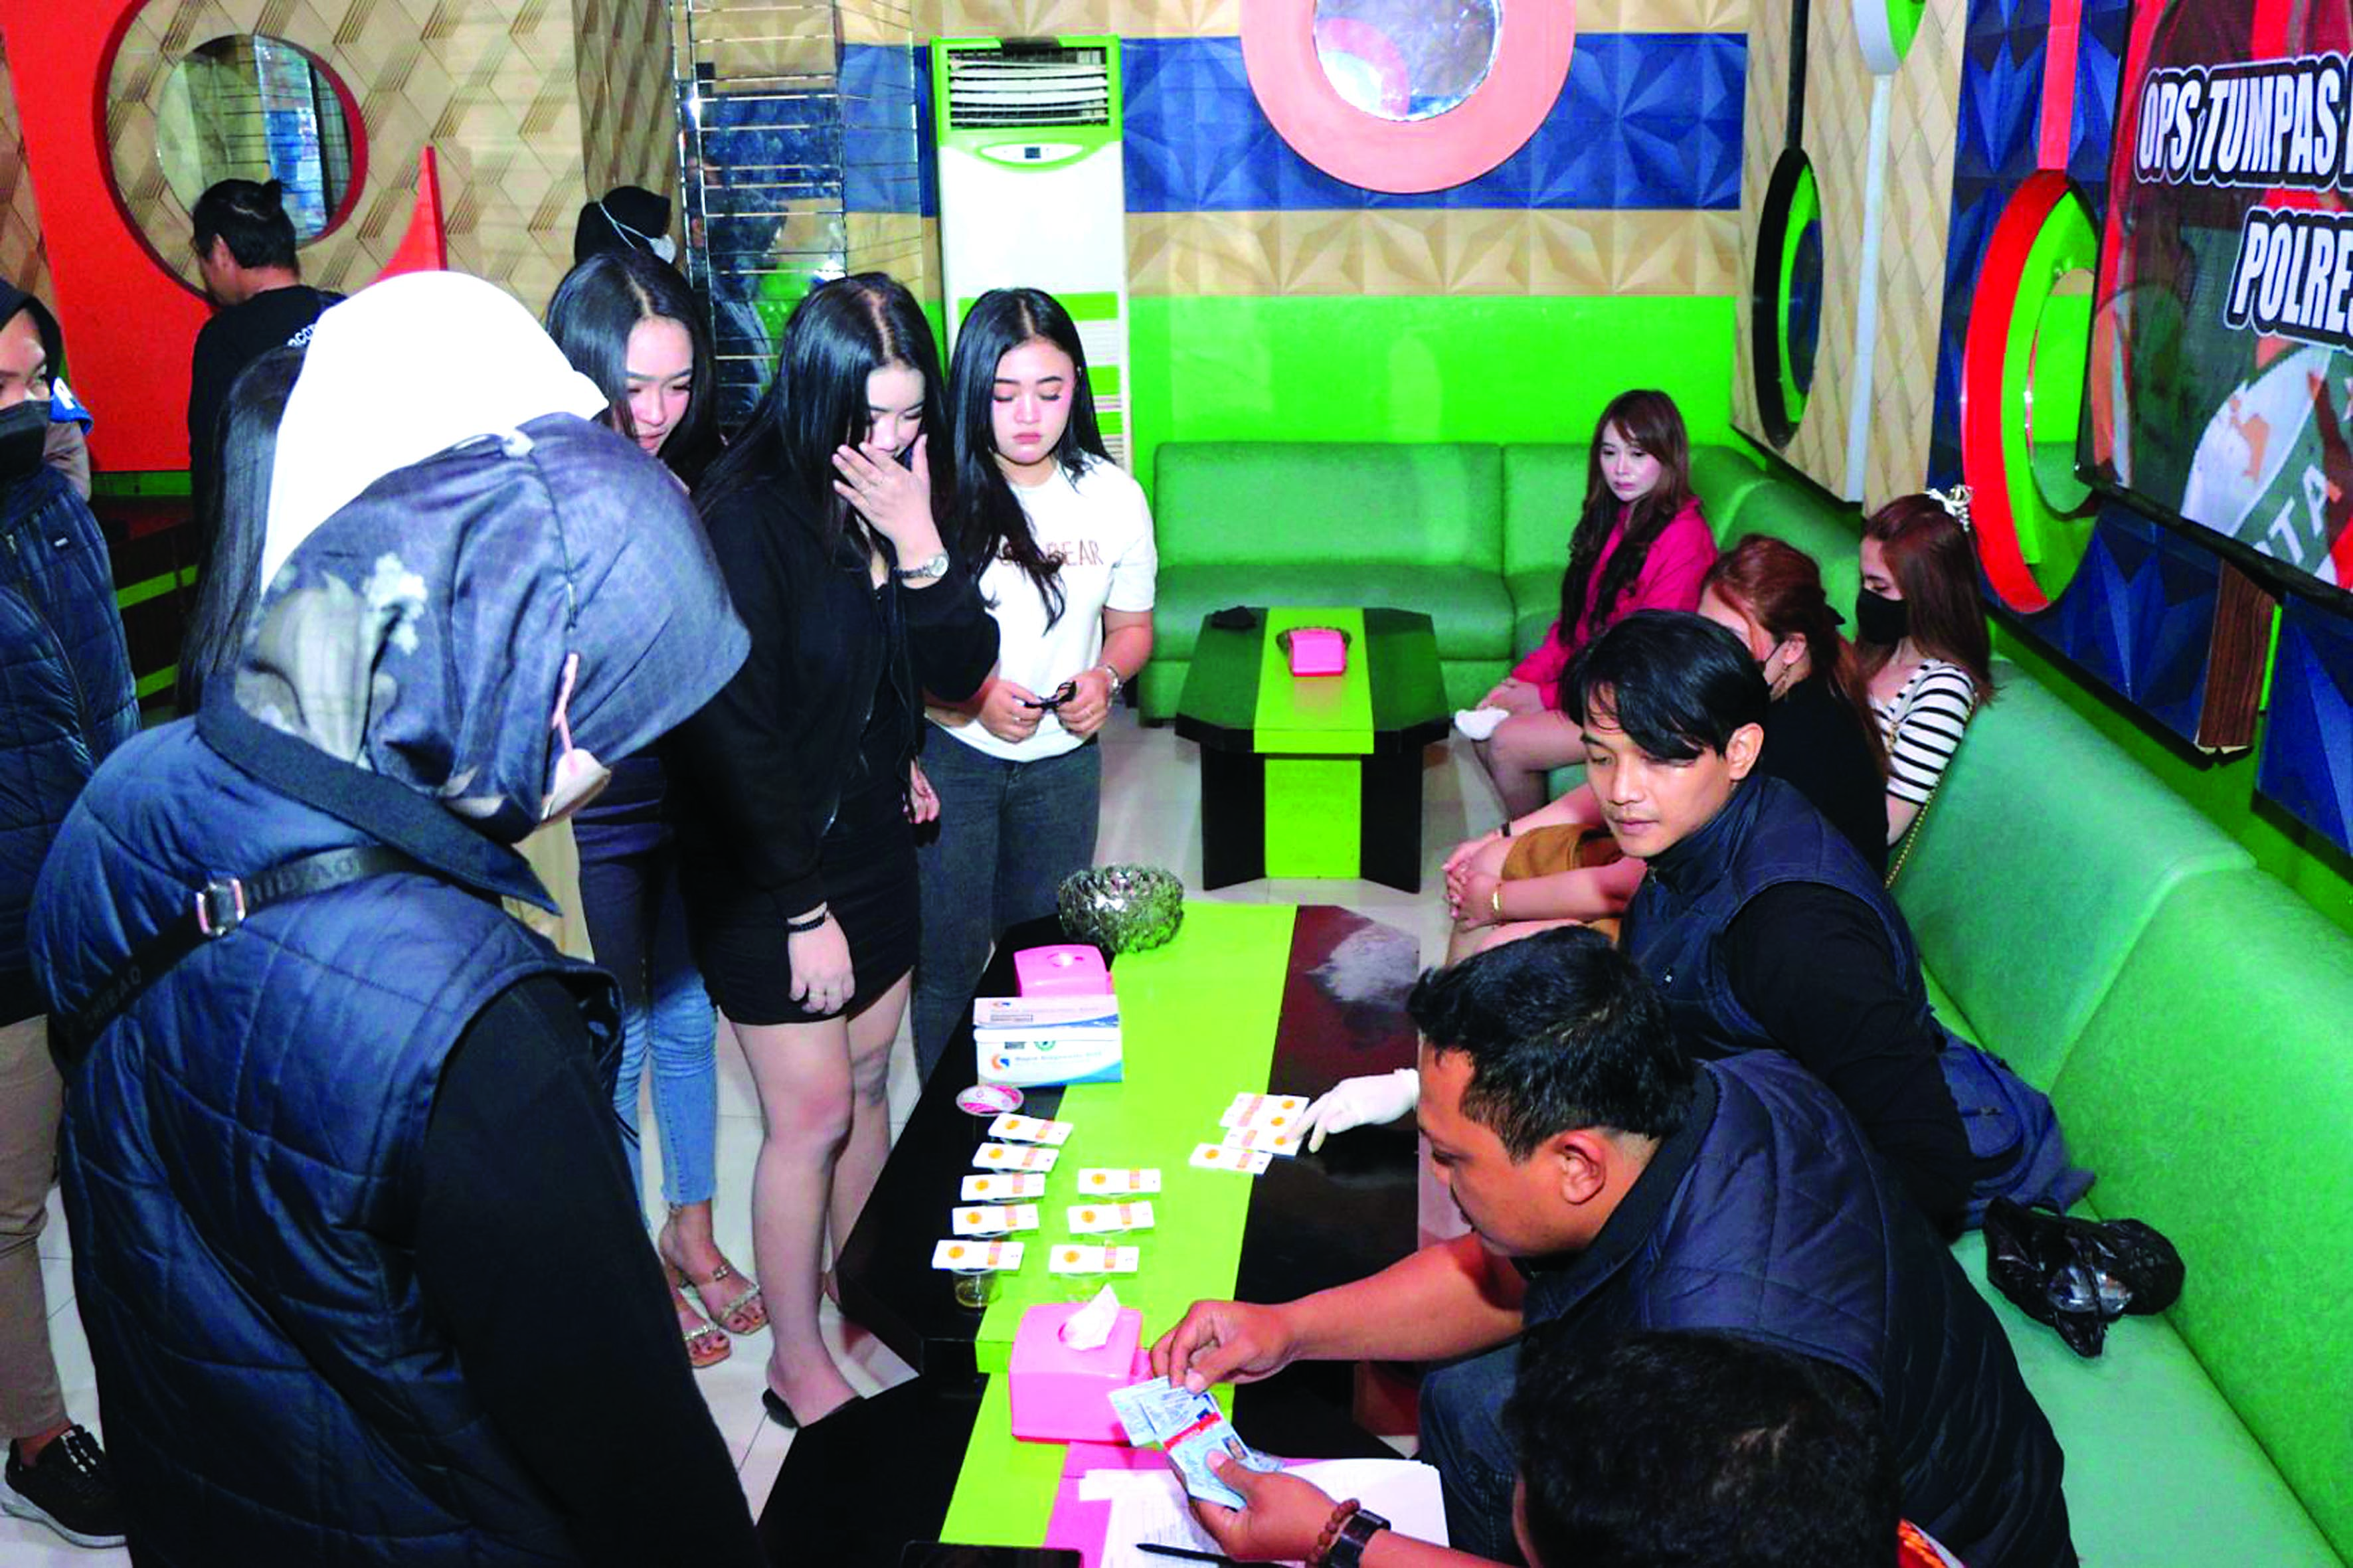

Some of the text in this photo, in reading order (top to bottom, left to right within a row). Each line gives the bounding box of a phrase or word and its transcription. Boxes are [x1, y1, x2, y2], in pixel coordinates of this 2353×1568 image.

[2139, 79, 2202, 171] OPS
[2198, 68, 2340, 176] TUMPAS
[2232, 220, 2353, 337] POLRE
